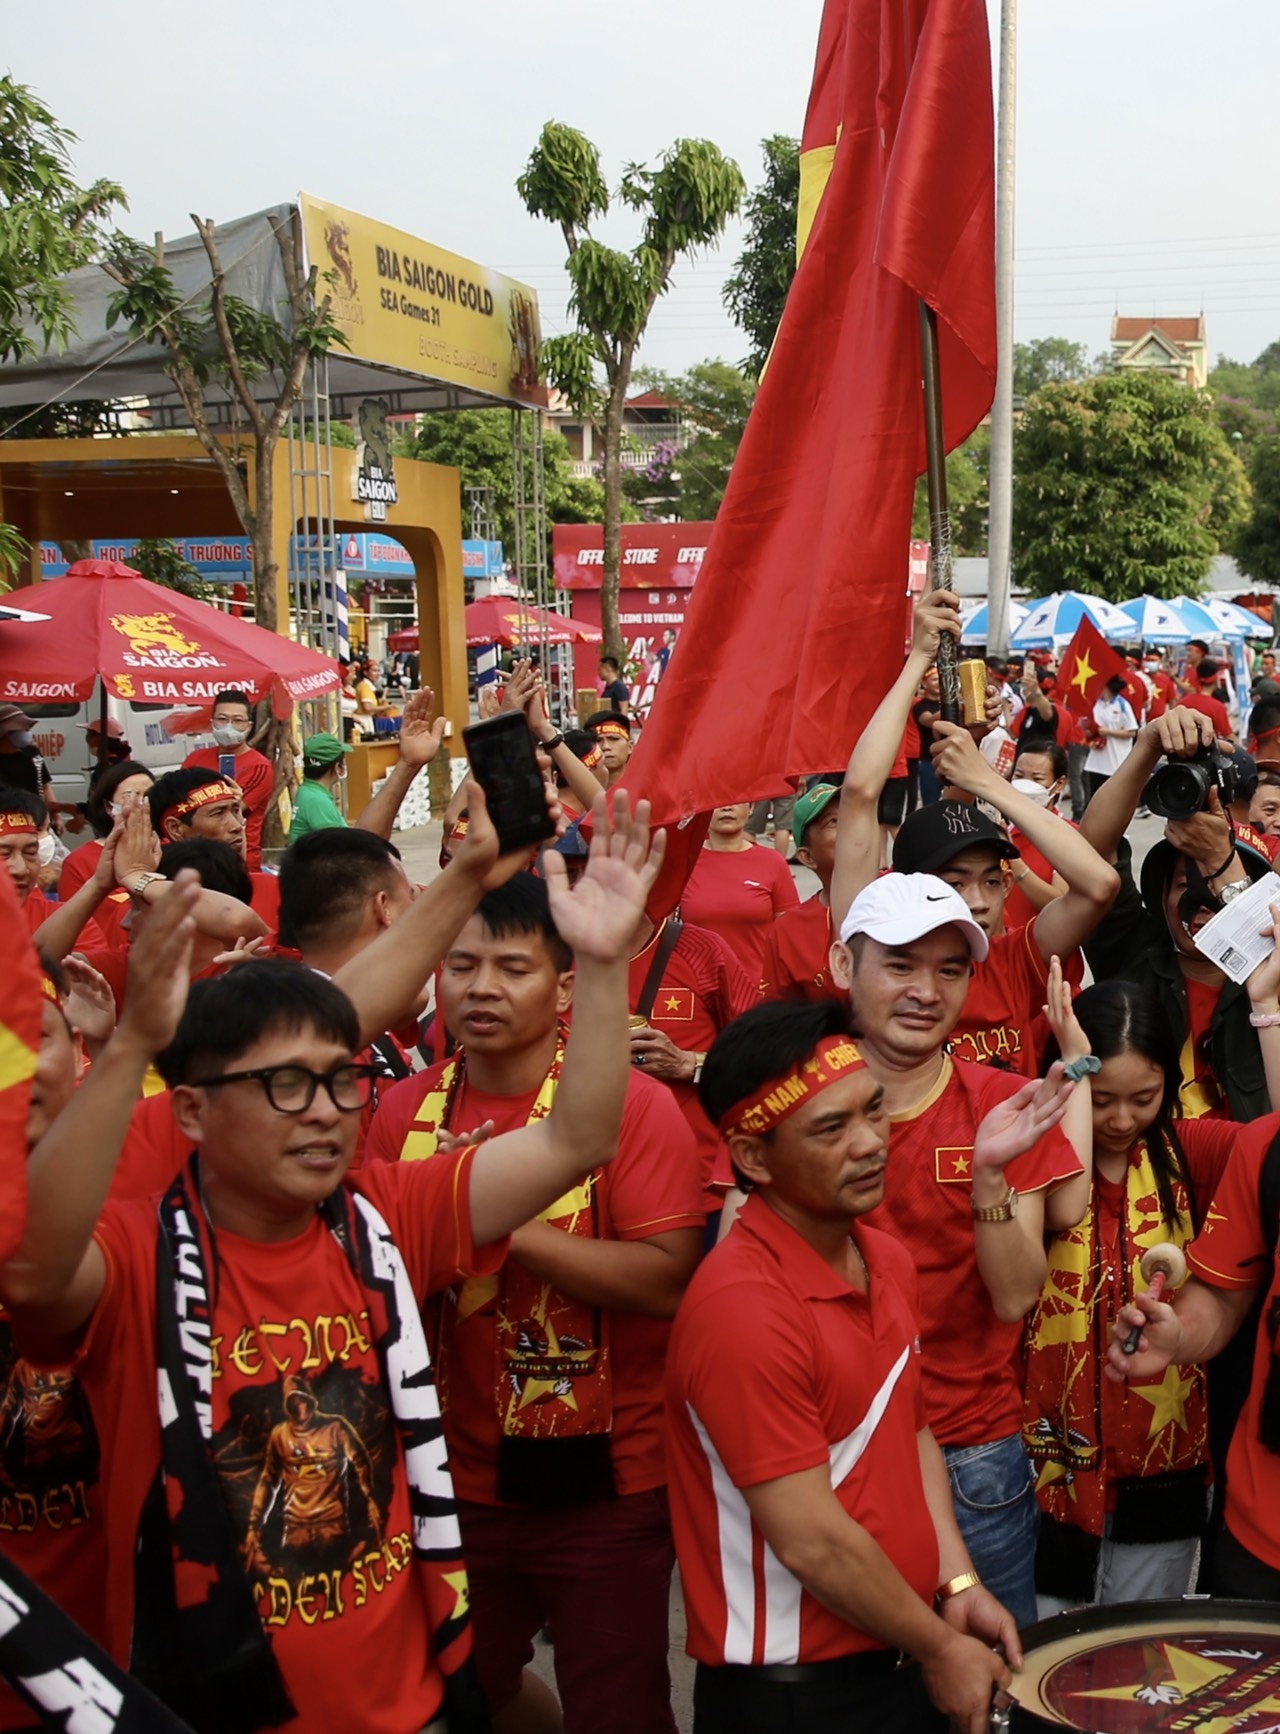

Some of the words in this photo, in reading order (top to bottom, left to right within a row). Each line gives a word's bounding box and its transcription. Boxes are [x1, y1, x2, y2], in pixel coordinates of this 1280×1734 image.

[375, 244, 401, 283] BIA
[404, 255, 455, 303] SAIGON
[458, 278, 493, 317] GOLD
[380, 287, 398, 314] SEA
[400, 296, 430, 322] Games
[431, 306, 440, 327] 31
[370, 466, 383, 480] BIA
[358, 478, 396, 501] SAIGON
[623, 548, 659, 564] STORE
[653, 612, 684, 623] VIETNAM
[151, 649, 180, 657] BIA
[143, 682, 177, 697] BIA
[288, 679, 303, 697] BIA
[302, 669, 338, 693] SAIGON
[763, 1074, 808, 1115] NAM
